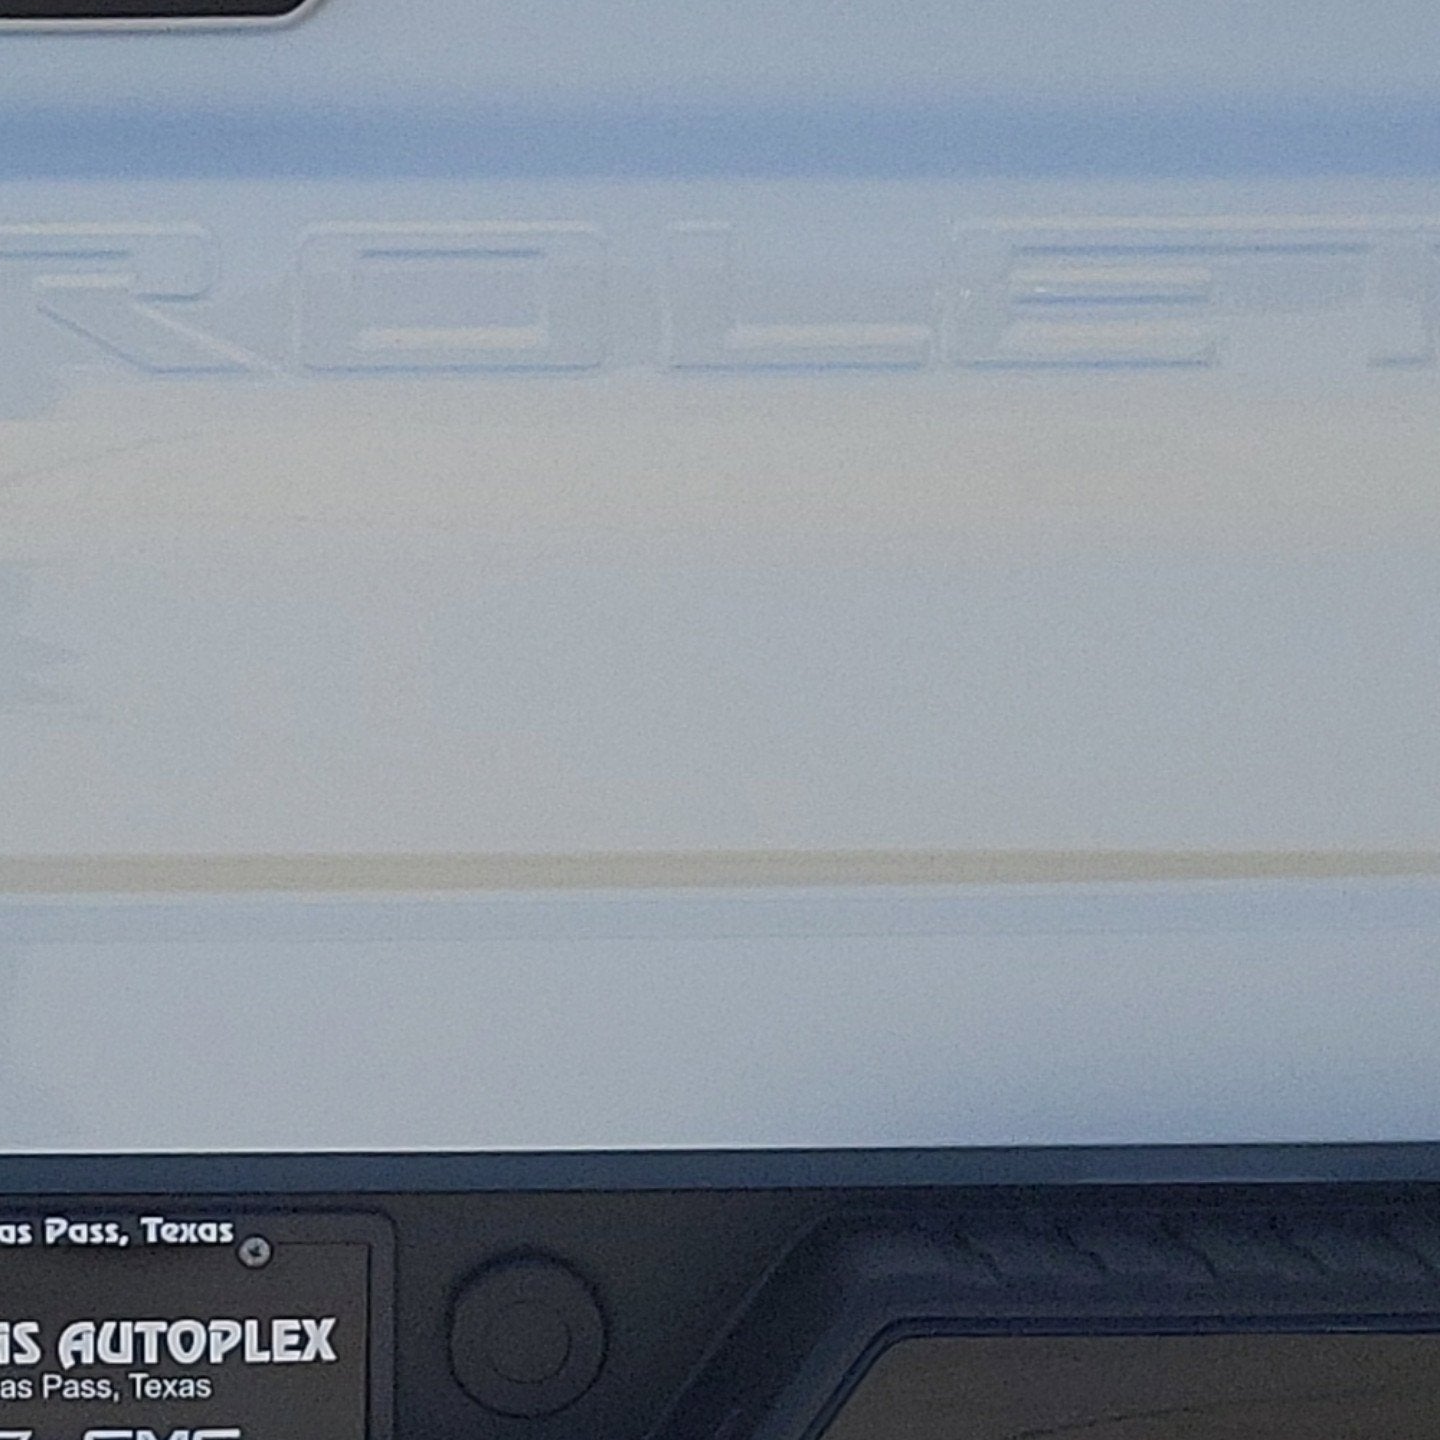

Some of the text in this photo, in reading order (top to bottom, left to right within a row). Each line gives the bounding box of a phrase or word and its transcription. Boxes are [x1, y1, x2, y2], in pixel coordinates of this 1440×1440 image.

[44, 1216, 130, 1247] Pass,
[140, 1216, 235, 1244] Texas
[58, 1317, 338, 1371] AUTOPLEX
[42, 1373, 120, 1403] Pass,
[128, 1372, 213, 1399] Texas
